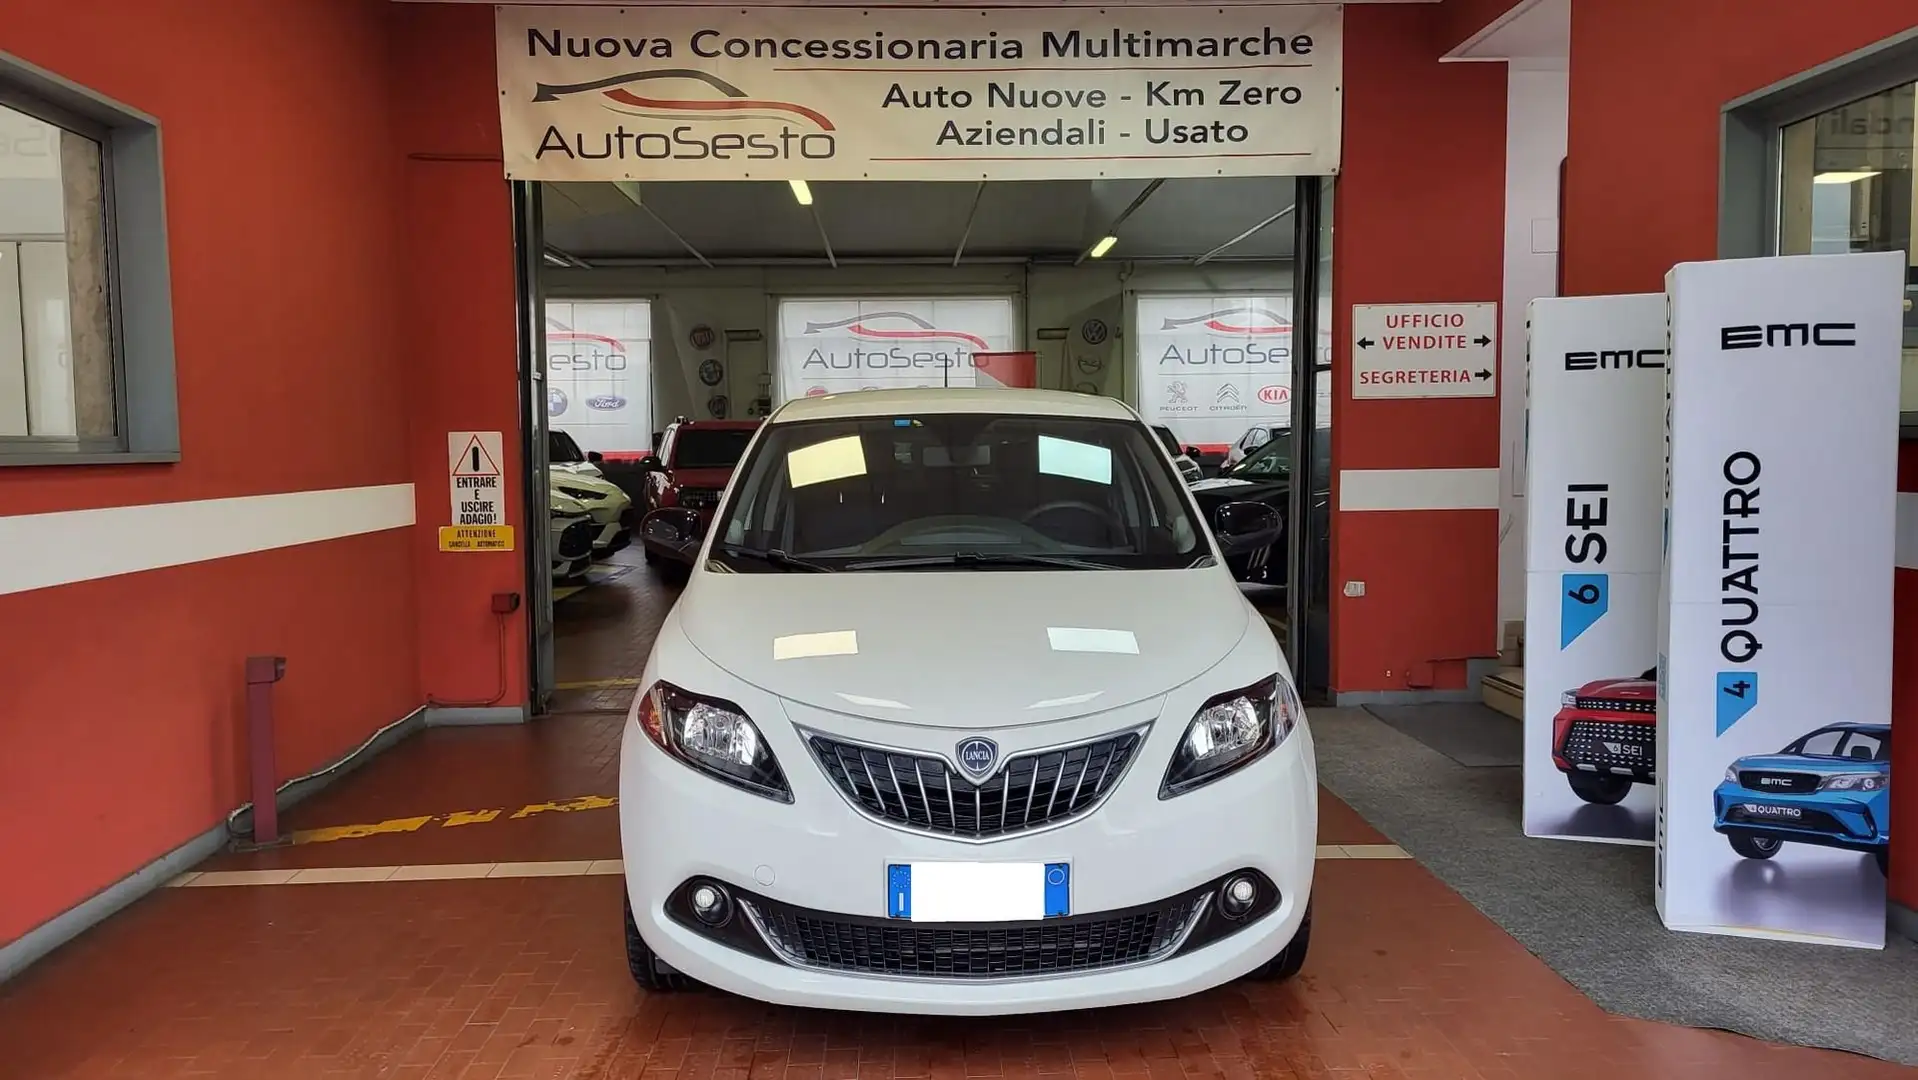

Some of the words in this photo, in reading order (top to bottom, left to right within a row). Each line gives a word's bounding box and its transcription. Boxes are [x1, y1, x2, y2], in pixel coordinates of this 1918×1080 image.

[527, 28, 672, 58] Nuova
[690, 30, 1023, 60] Concessionaria
[1042, 27, 1314, 58] Multimarche
[882, 83, 973, 109] Auto
[988, 82, 1107, 109] Nuove
[1146, 81, 1205, 106] Km
[1218, 80, 1302, 105] Zero
[936, 118, 1106, 147] Aziendali
[1145, 118, 1249, 144] Usato
[535, 126, 836, 160] AutoSesto
[1386, 313, 1464, 329] UFFICIO
[1383, 335, 1467, 350] VENDITE
[549, 350, 627, 371] esto
[803, 347, 990, 370] AutoSesto
[1159, 343, 1289, 365] AutoSe
[1359, 370, 1471, 384] SEGRETERIA
[1263, 389, 1288, 400] KIA
[456, 477, 497, 488] ENTRARE
[474, 489, 480, 500] E
[461, 501, 494, 513] USCIRE
[460, 513, 497, 525] ADAGIO!
[1565, 483, 1609, 564] SEI
[456, 529, 496, 538] ATTENZIONE
[1721, 451, 1763, 663] QUATTRO
[1568, 583, 1600, 605] 6
[1723, 680, 1751, 700] 4
[965, 750, 990, 760] LANCIA
[1622, 744, 1643, 756] SEI
[1757, 805, 1801, 817] QUATTRO
